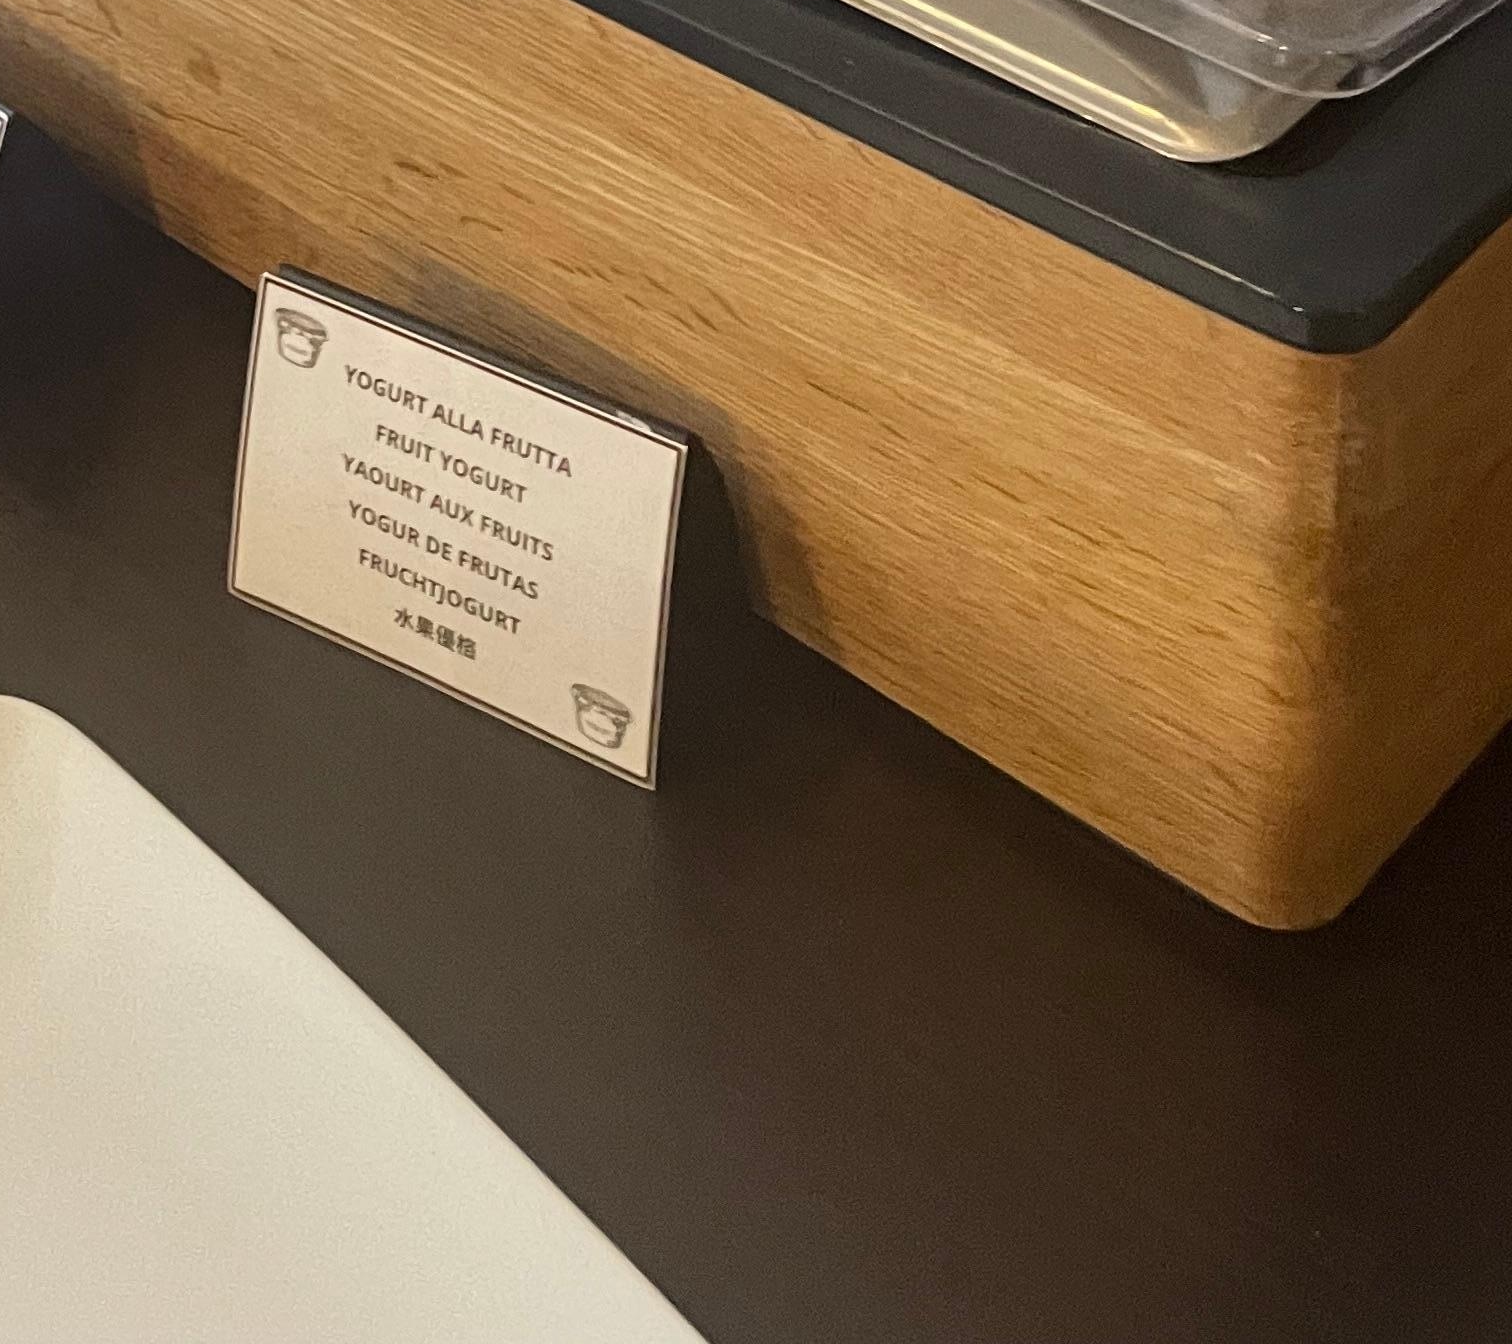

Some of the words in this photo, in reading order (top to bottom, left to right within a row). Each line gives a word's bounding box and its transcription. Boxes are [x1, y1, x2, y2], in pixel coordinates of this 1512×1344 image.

[343, 364, 429, 416] YOGURT
[432, 403, 484, 441] ALLA
[489, 427, 573, 478] FRUTTA
[375, 424, 435, 464] FRUIT
[439, 450, 528, 504] YOGURT
[342, 454, 425, 505] YAOURT
[430, 494, 475, 527] AUX
[480, 515, 554, 561] FRUITS
[349, 500, 420, 548] YOGUR
[425, 533, 453, 562] DE
[458, 551, 539, 599] FRUTAS
[359, 548, 522, 635] FRUCHTJOGURT
